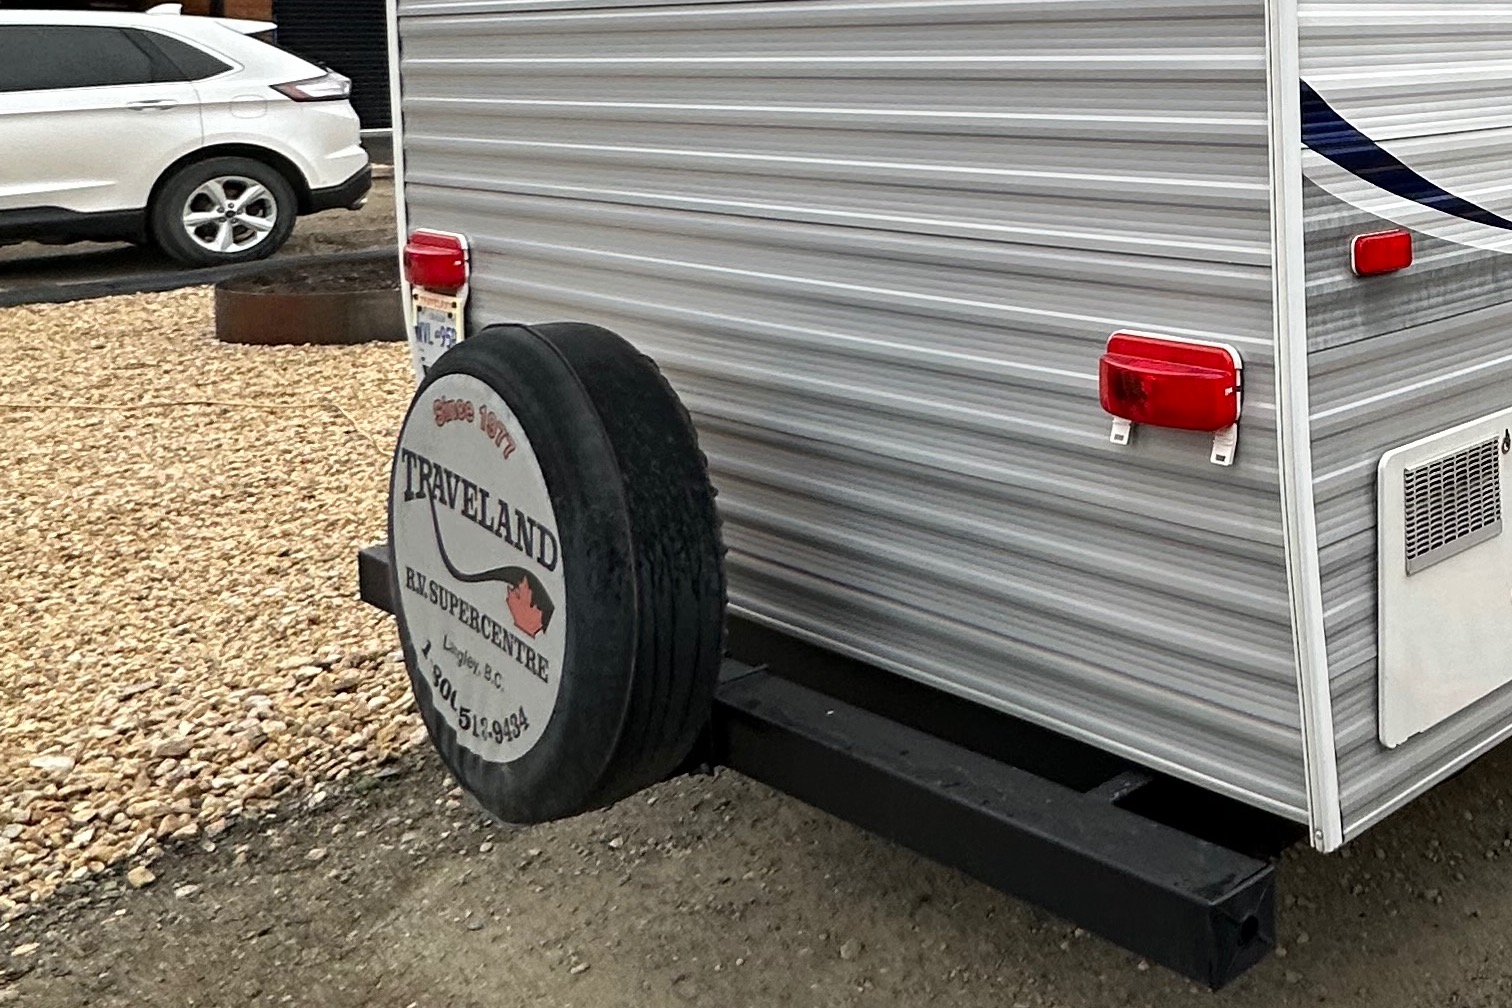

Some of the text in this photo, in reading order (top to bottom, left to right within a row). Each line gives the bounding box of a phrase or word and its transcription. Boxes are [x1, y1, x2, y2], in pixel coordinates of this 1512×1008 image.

[433, 395, 475, 428] Since
[402, 447, 558, 573] TRAVELAND
[429, 580, 549, 684] SUPERCENTRE
